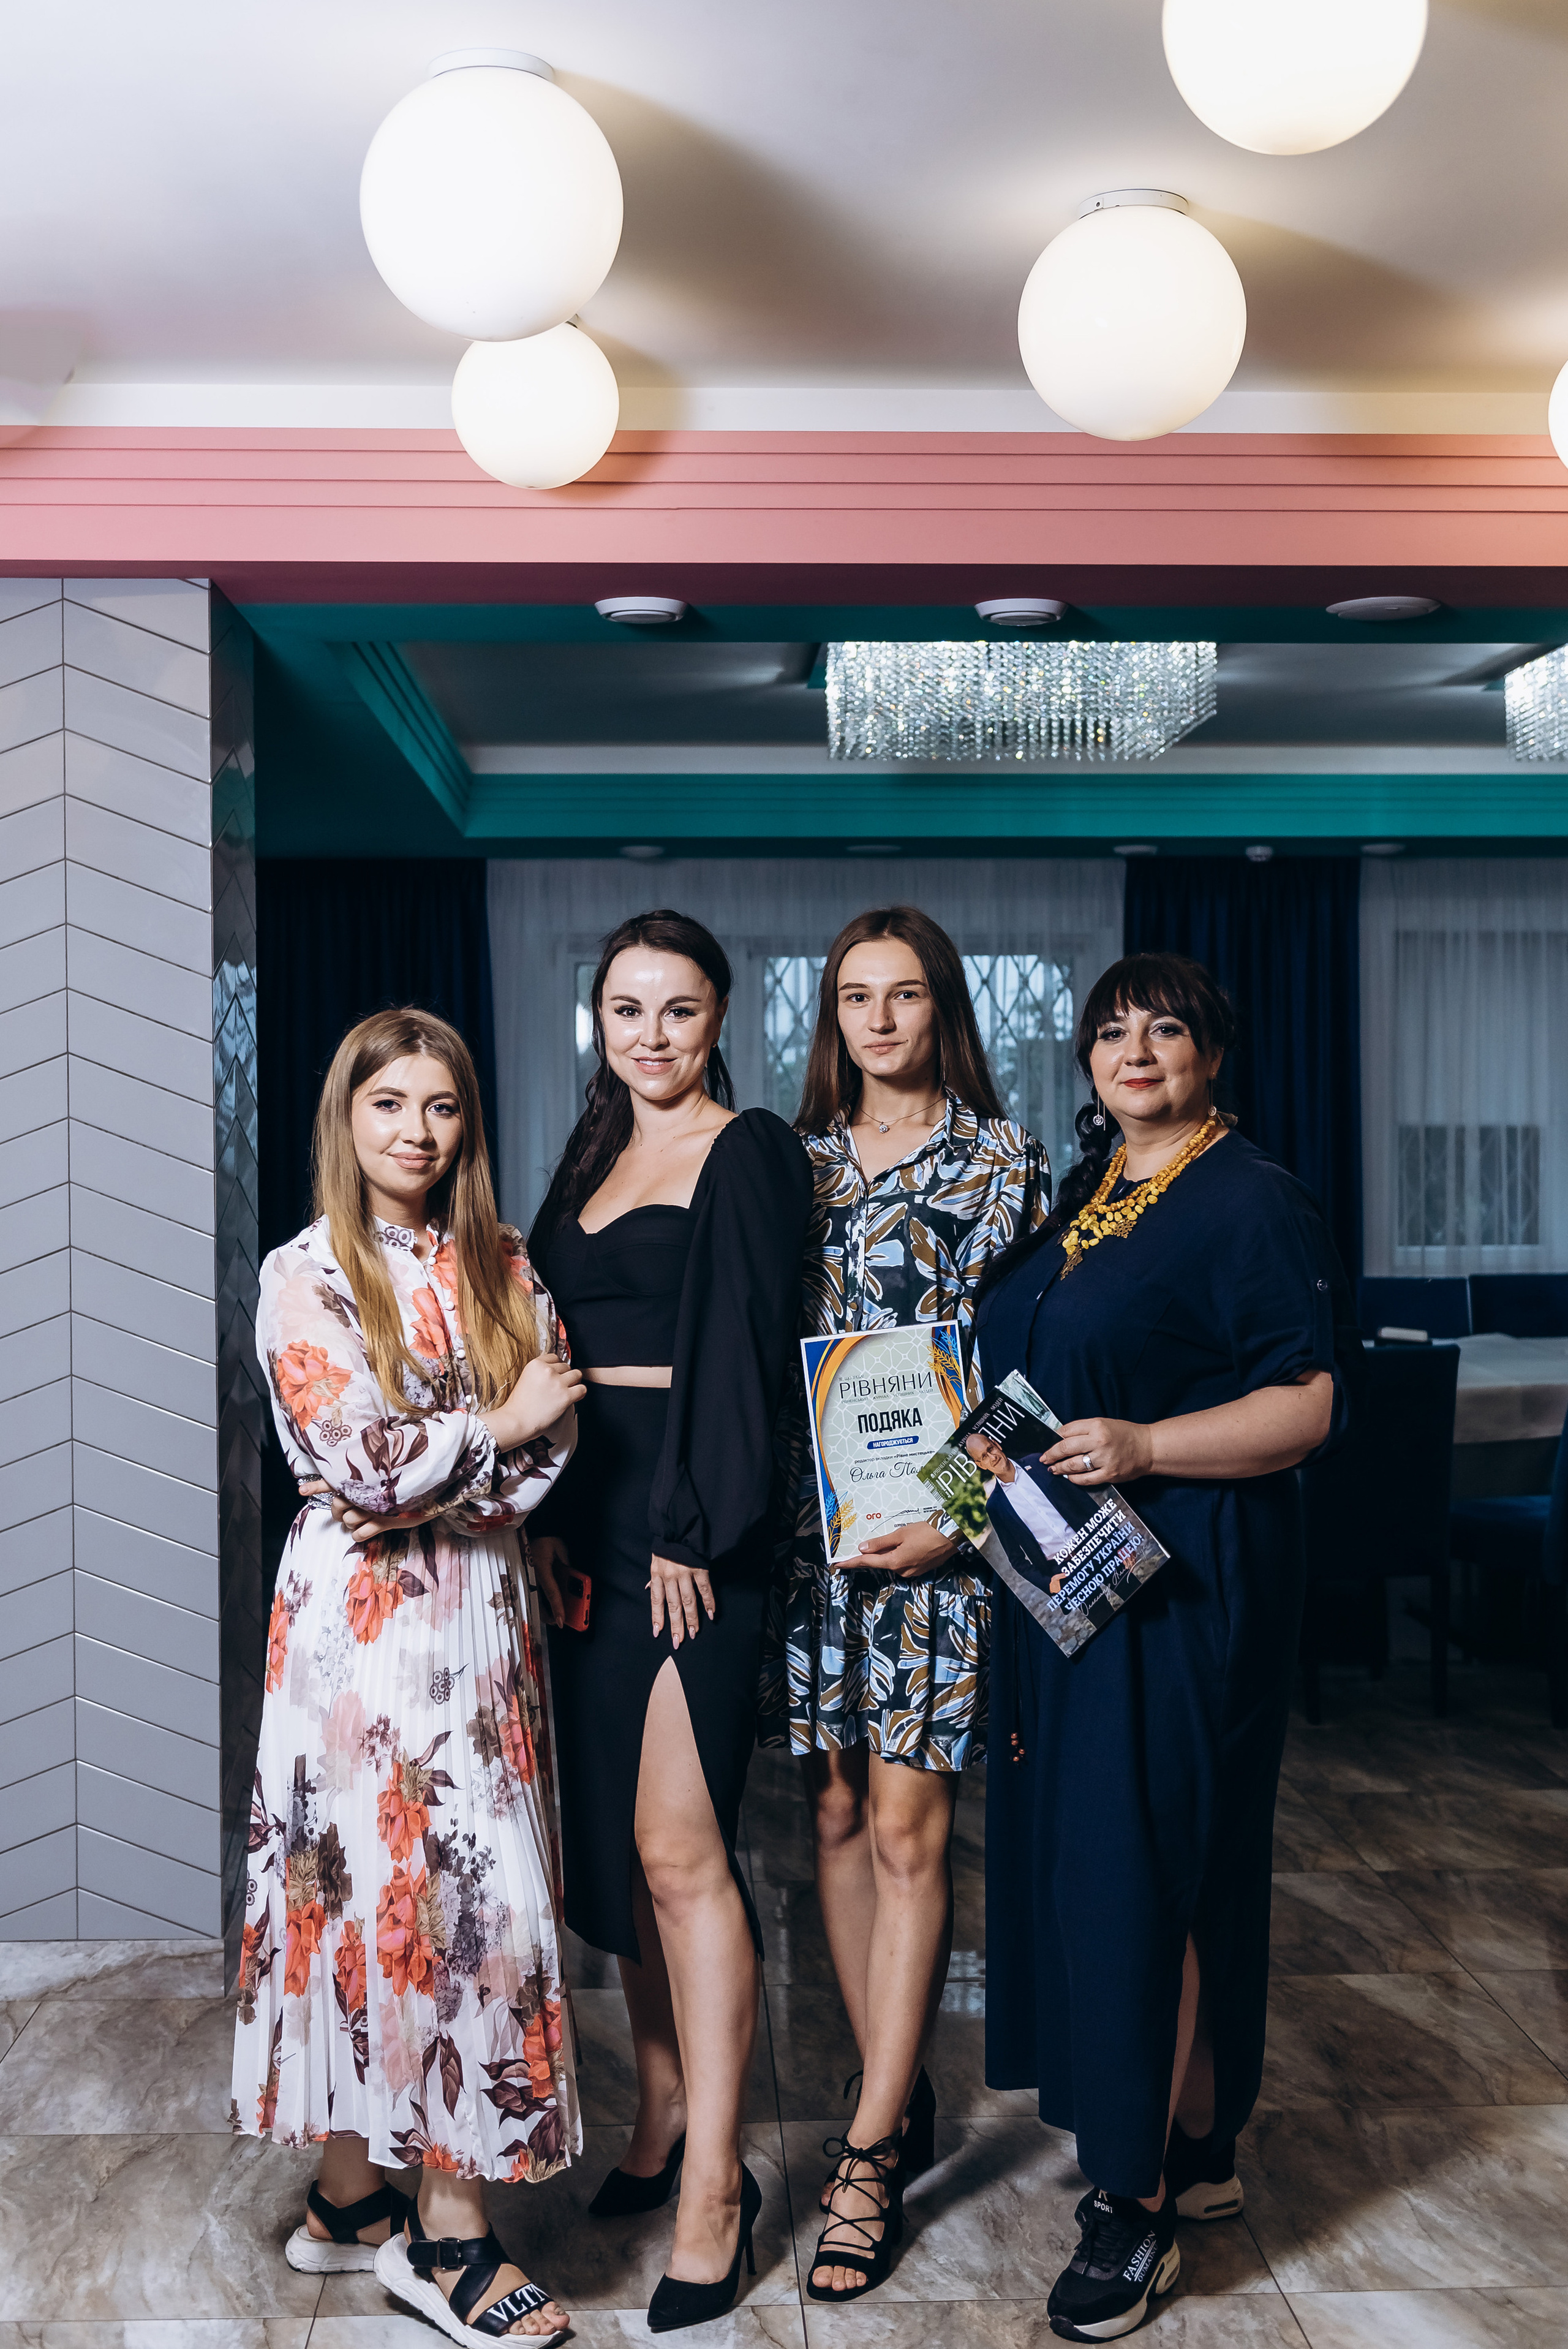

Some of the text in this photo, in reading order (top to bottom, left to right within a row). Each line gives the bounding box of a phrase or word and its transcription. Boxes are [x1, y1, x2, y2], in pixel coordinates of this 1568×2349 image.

[840, 1372, 932, 1399] РІВНЯНИ
[858, 1407, 923, 1434] ПОДЯКА
[850, 1466, 886, 1483] Ольга
[1052, 1527, 1089, 1565] КОЖЕН
[1084, 1498, 1118, 1534] МОЖЕ
[1061, 1509, 1127, 1577] ЗАБЕЗПЕЧИТИ
[1046, 1559, 1095, 1613] ПЕРЕМОГУ
[1093, 1521, 1136, 1565] УКРАЇНИ
[1065, 1573, 1104, 1611] ЧЕСНОЮ
[1101, 1532, 1145, 1578] ПРАЦЕЮ!
[1094, 2200, 1113, 2214] SPORT
[1123, 2230, 1156, 2282] FASHION
